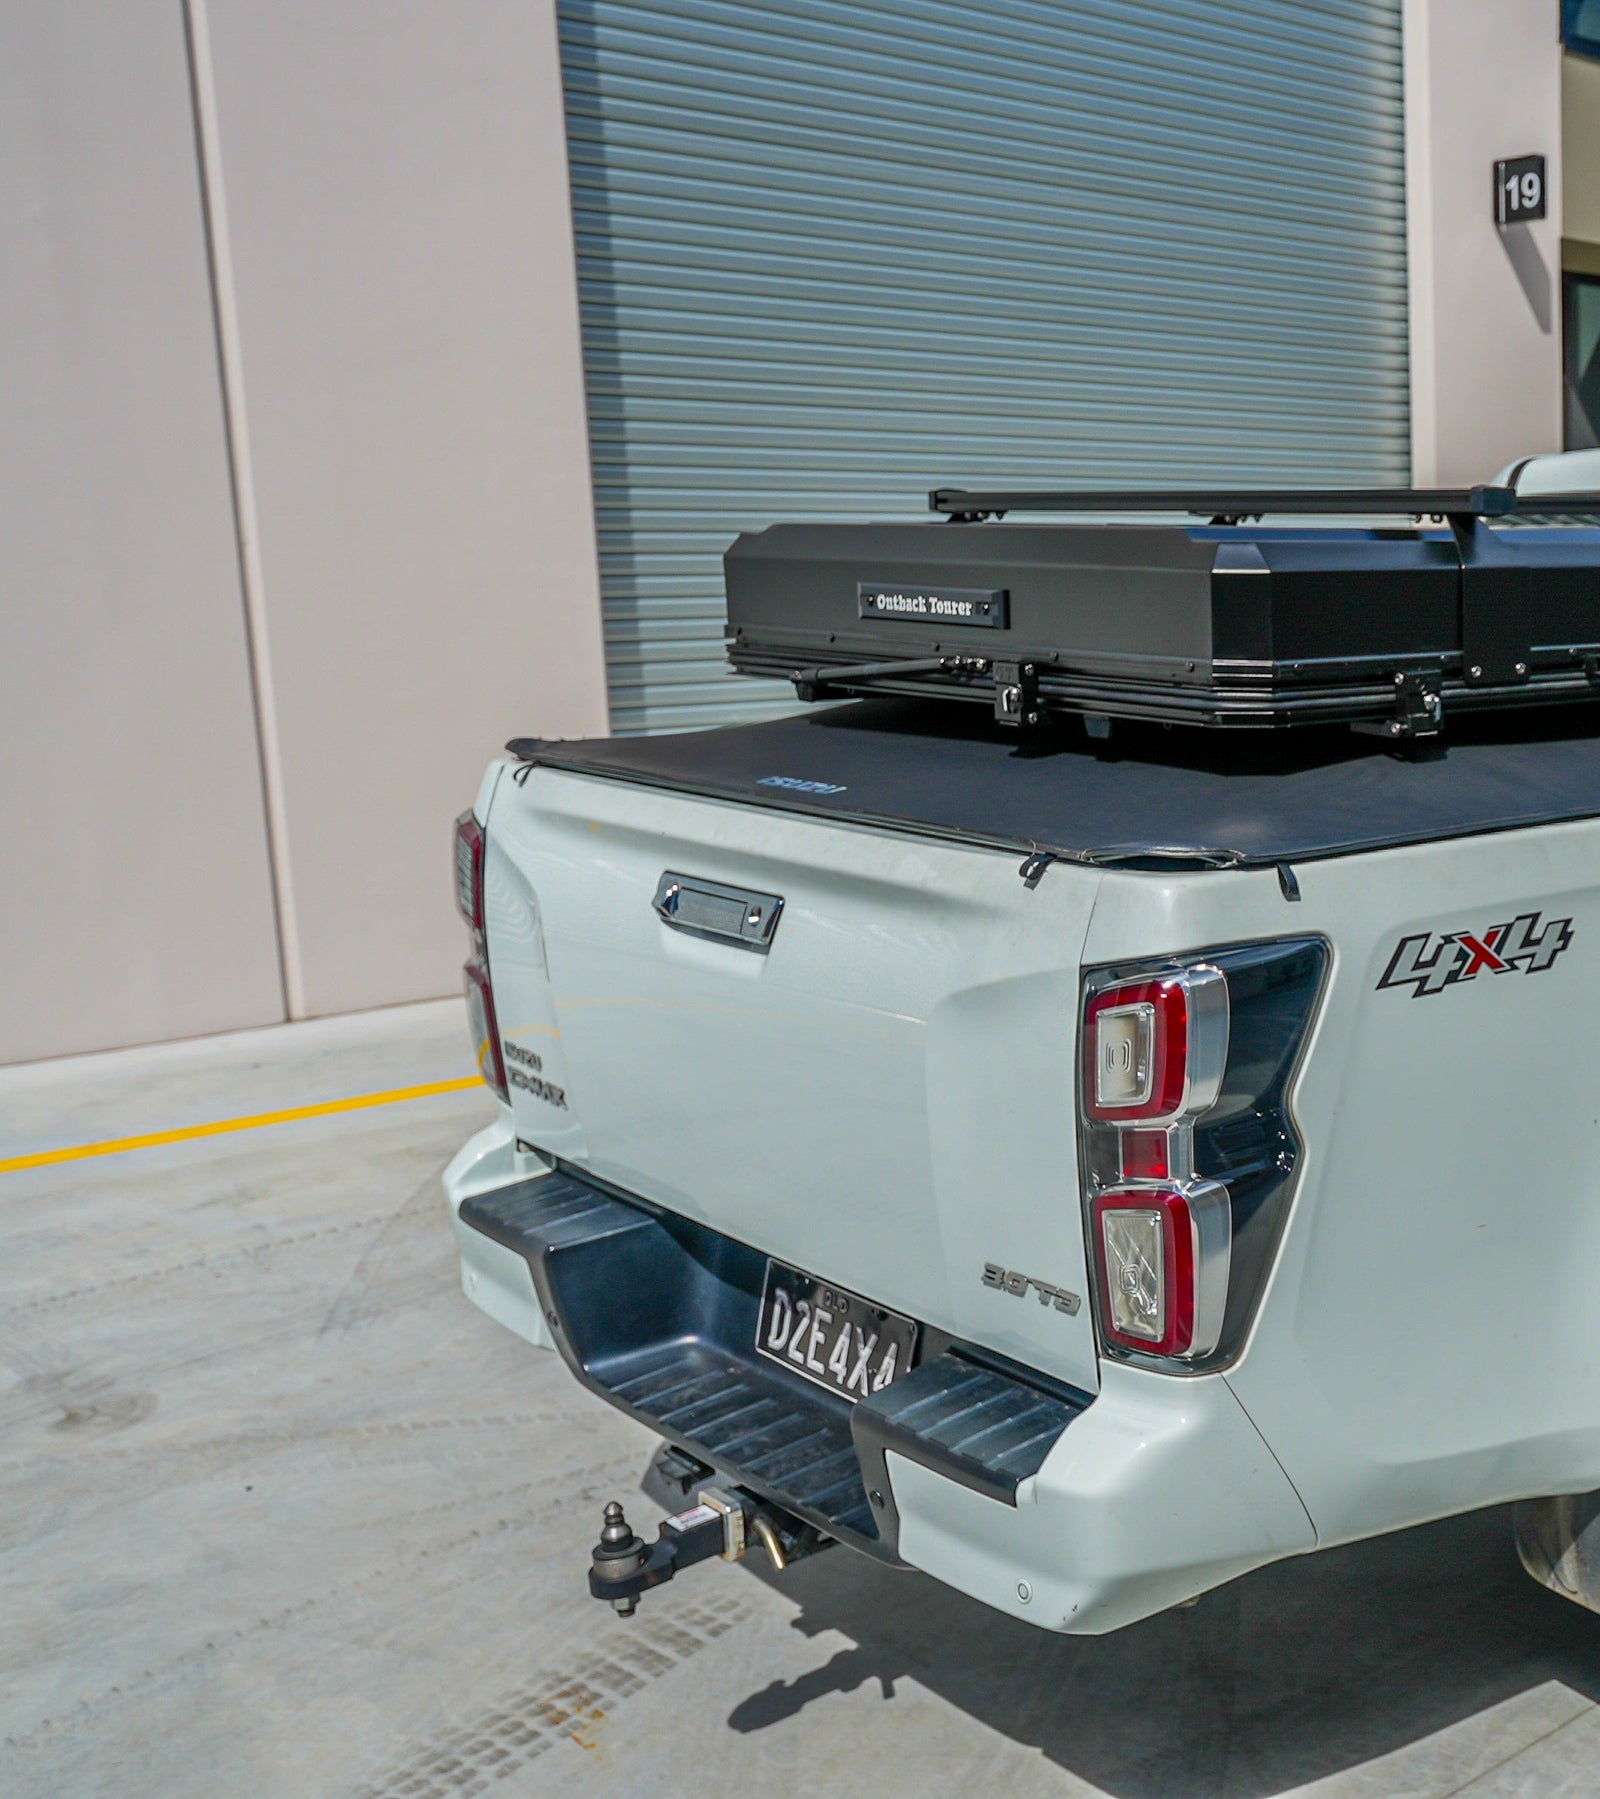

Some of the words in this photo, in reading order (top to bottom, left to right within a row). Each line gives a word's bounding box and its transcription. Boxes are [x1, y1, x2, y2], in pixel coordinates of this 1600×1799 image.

[1505, 172, 1541, 210] 19
[876, 593, 927, 614] Outback
[928, 597, 973, 617] Tourer
[756, 776, 847, 795] ISUZU
